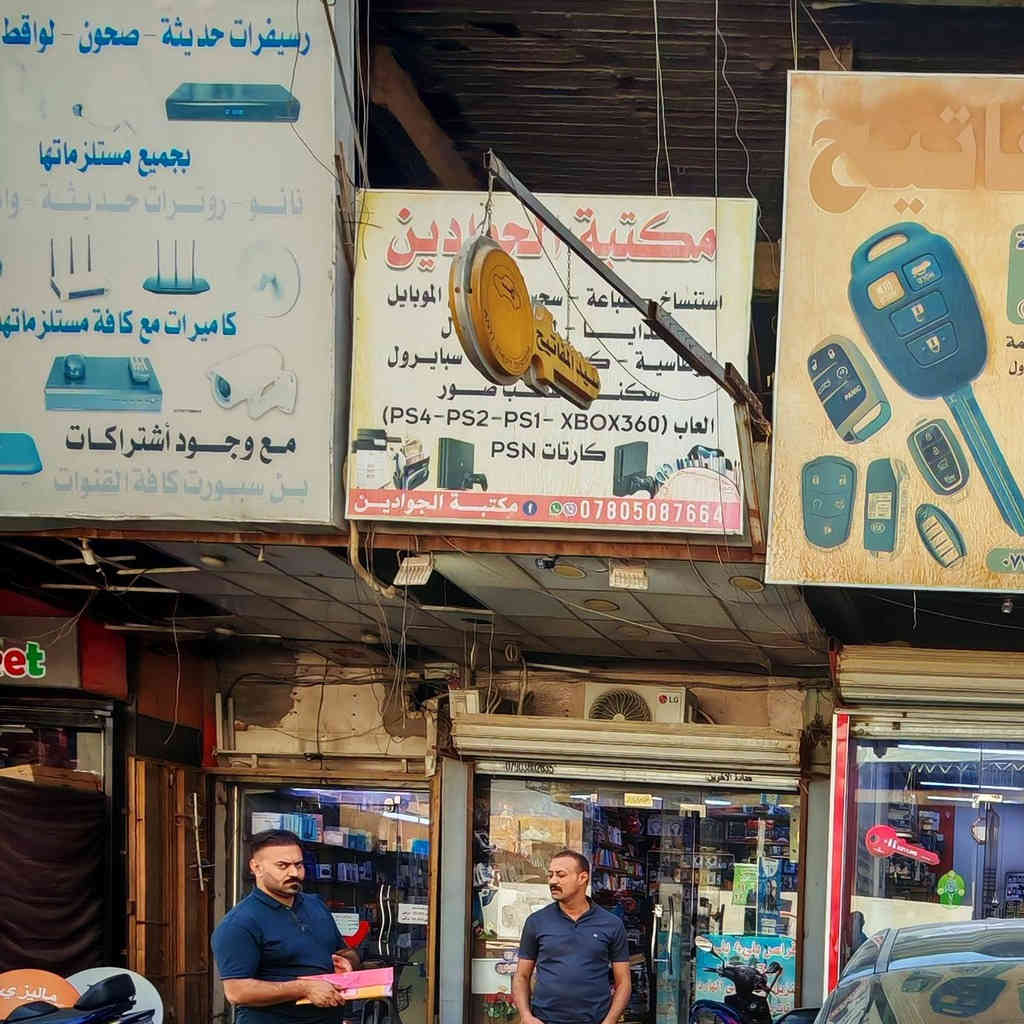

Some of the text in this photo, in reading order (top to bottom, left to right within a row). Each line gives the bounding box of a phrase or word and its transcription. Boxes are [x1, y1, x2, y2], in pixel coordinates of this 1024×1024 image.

[1, 14, 311, 57] رسيفرات حديثة صحون لواقط
[39, 138, 191, 177] بجميع مستلزماتها
[573, 205, 719, 268] مكتبة
[387, 283, 442, 308] الموبايل
[93, 309, 238, 344] كاميرات مع كافة
[65, 422, 297, 465] مع وجود أشتراكات
[674, 421, 715, 438] العاب
[490, 441, 606, 466] كارتات PSN
[134, 468, 179, 494] كافة
[354, 493, 518, 516] مكتبة الجوادين
[580, 500, 723, 524] 07805087664
[0, 641, 46, 679] et
